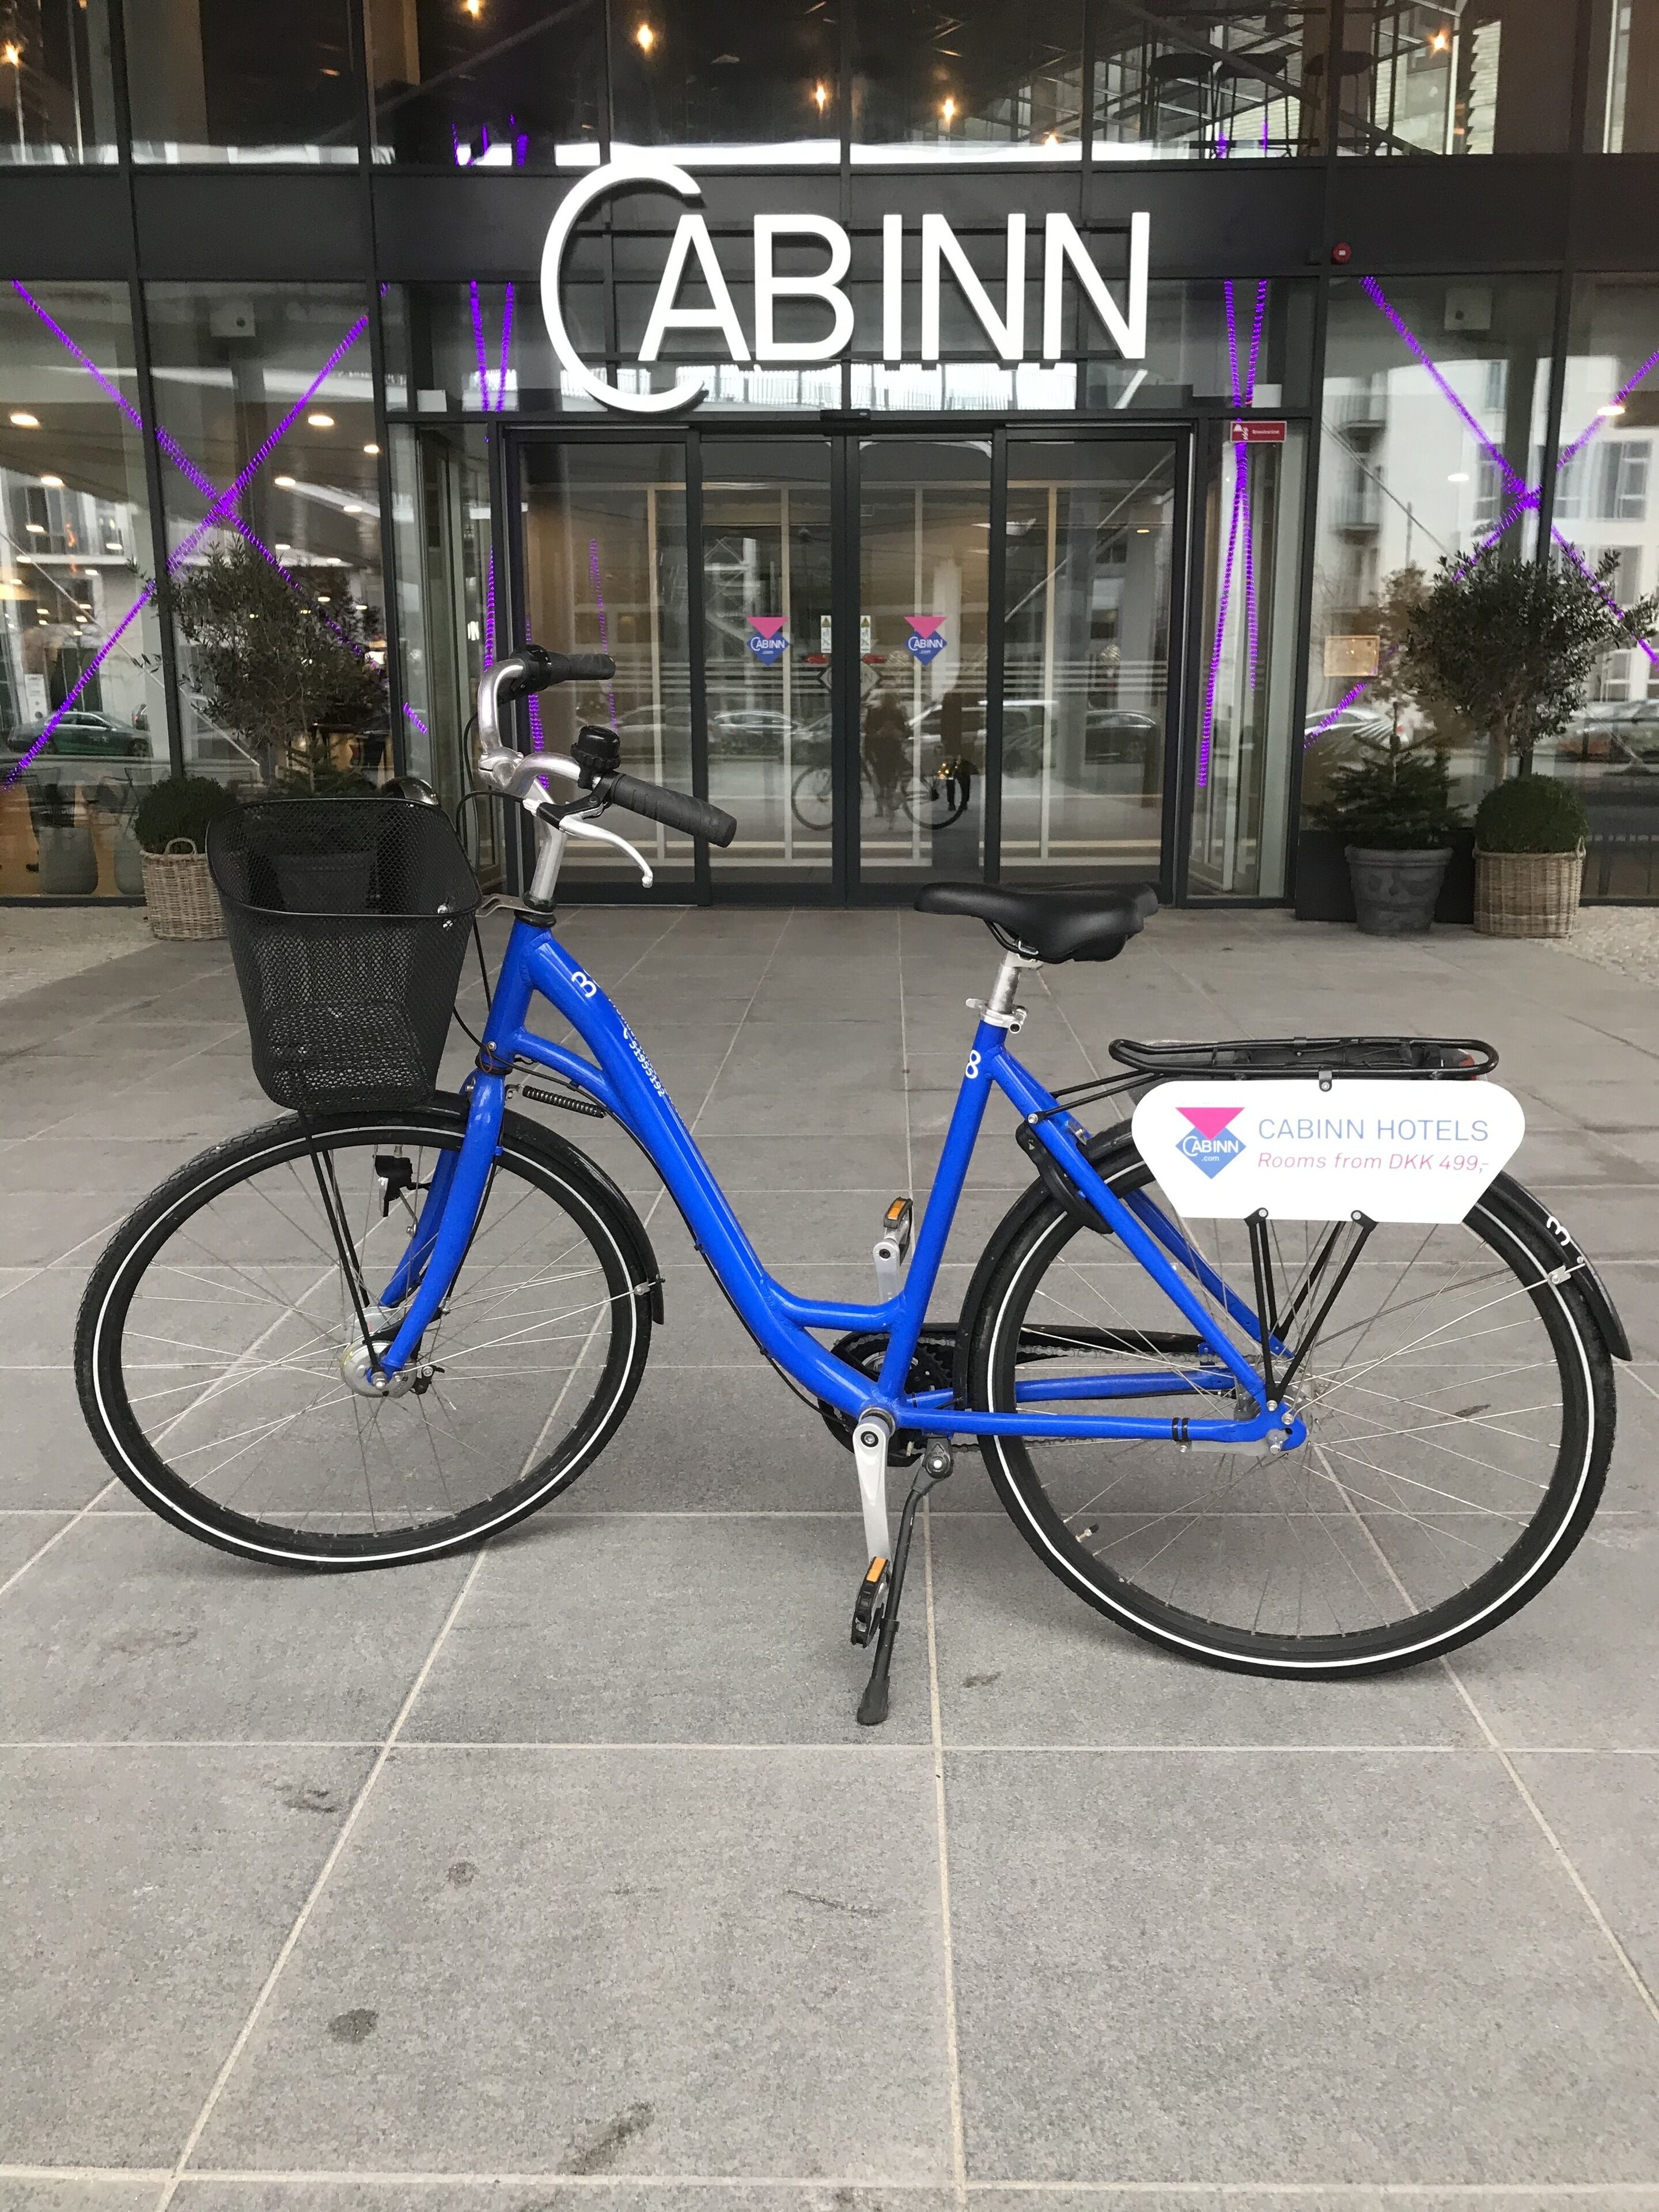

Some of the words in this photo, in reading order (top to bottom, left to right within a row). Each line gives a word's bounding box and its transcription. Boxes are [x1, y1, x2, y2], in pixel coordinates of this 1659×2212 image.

[541, 160, 1150, 412] CABINN
[751, 637, 785, 651] CABINN
[908, 637, 943, 651] CABINN
[628, 1040, 665, 1097] 51955192
[1259, 1119, 1364, 1139] CABINN
[1378, 1119, 1488, 1142] HOTELS
[1183, 1135, 1238, 1157] CABINN
[1258, 1152, 1326, 1168] Rooms
[1335, 1153, 1381, 1169] from
[1389, 1153, 1434, 1170] DKK
[1439, 1154, 1489, 1173] 499,-
